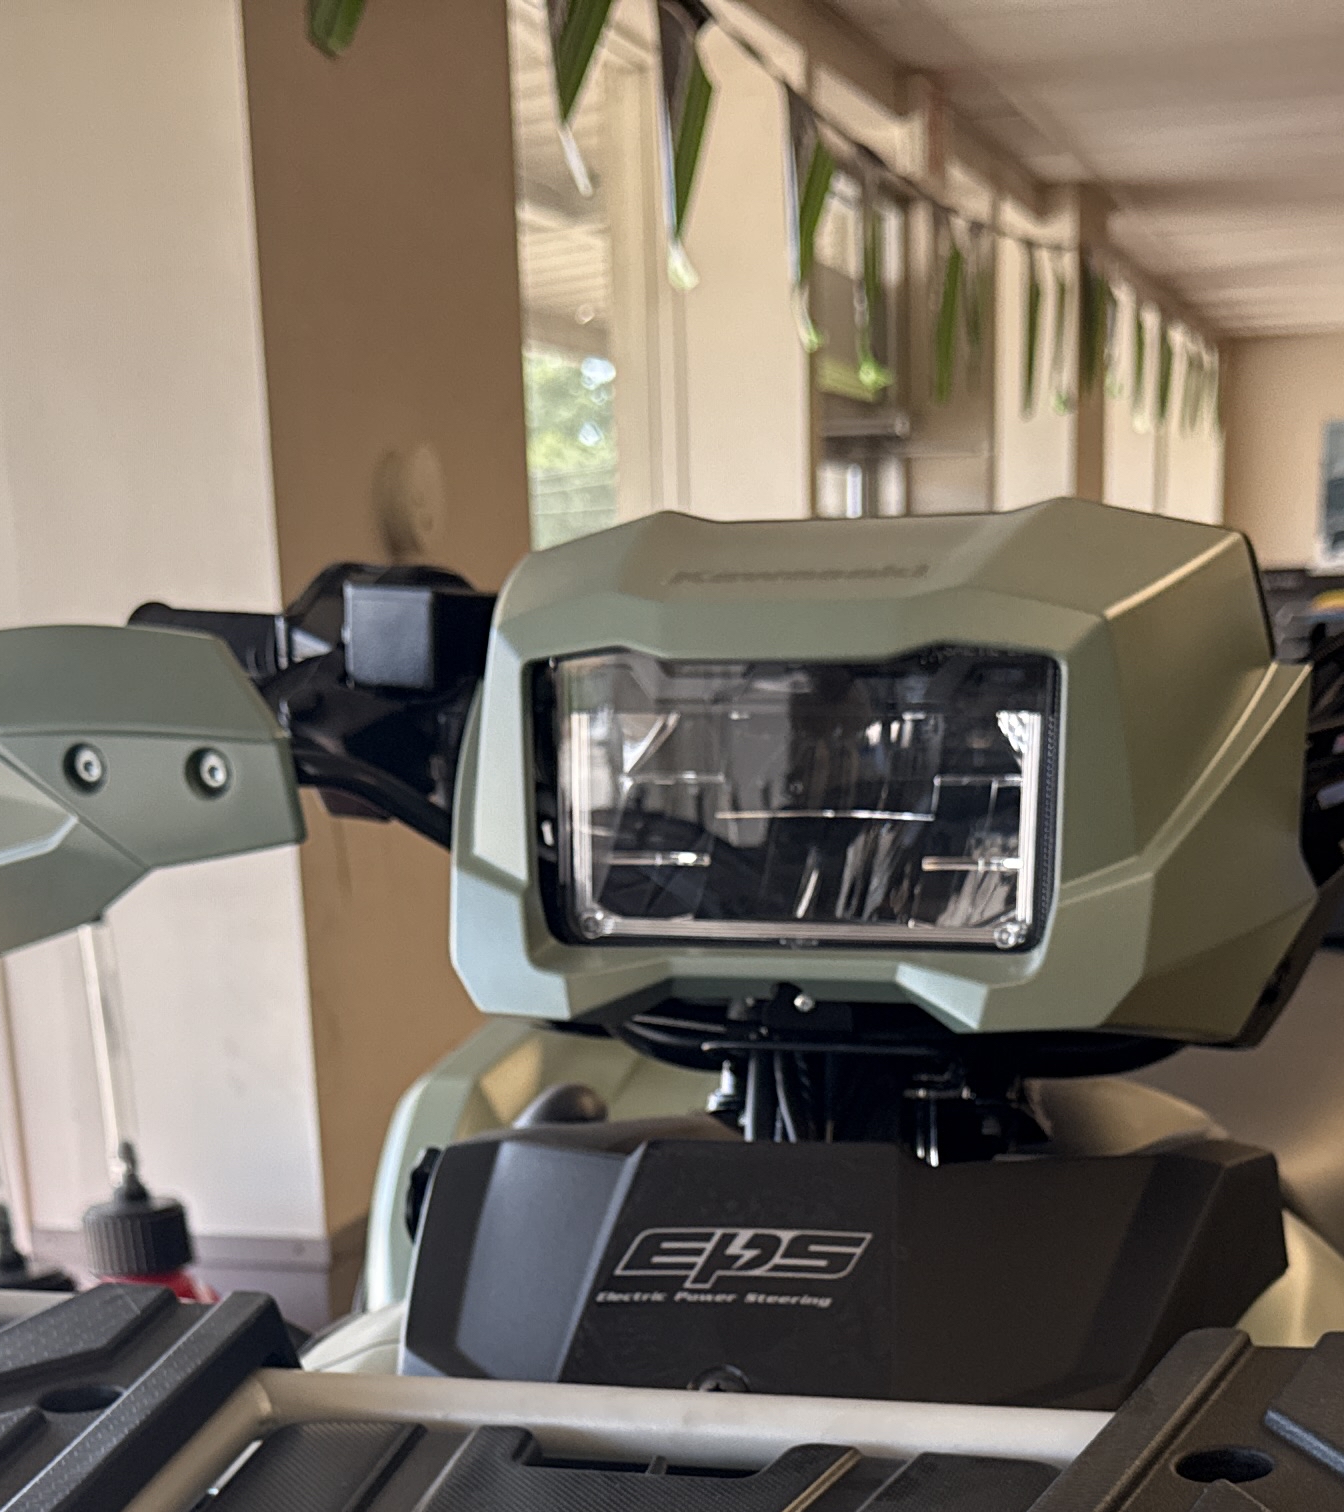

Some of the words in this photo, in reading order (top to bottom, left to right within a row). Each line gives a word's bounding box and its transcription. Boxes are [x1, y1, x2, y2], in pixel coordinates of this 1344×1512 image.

[613, 1227, 873, 1289] EPS
[595, 1290, 666, 1303] Electric
[674, 1291, 737, 1303] Power
[743, 1292, 832, 1308] Steering
